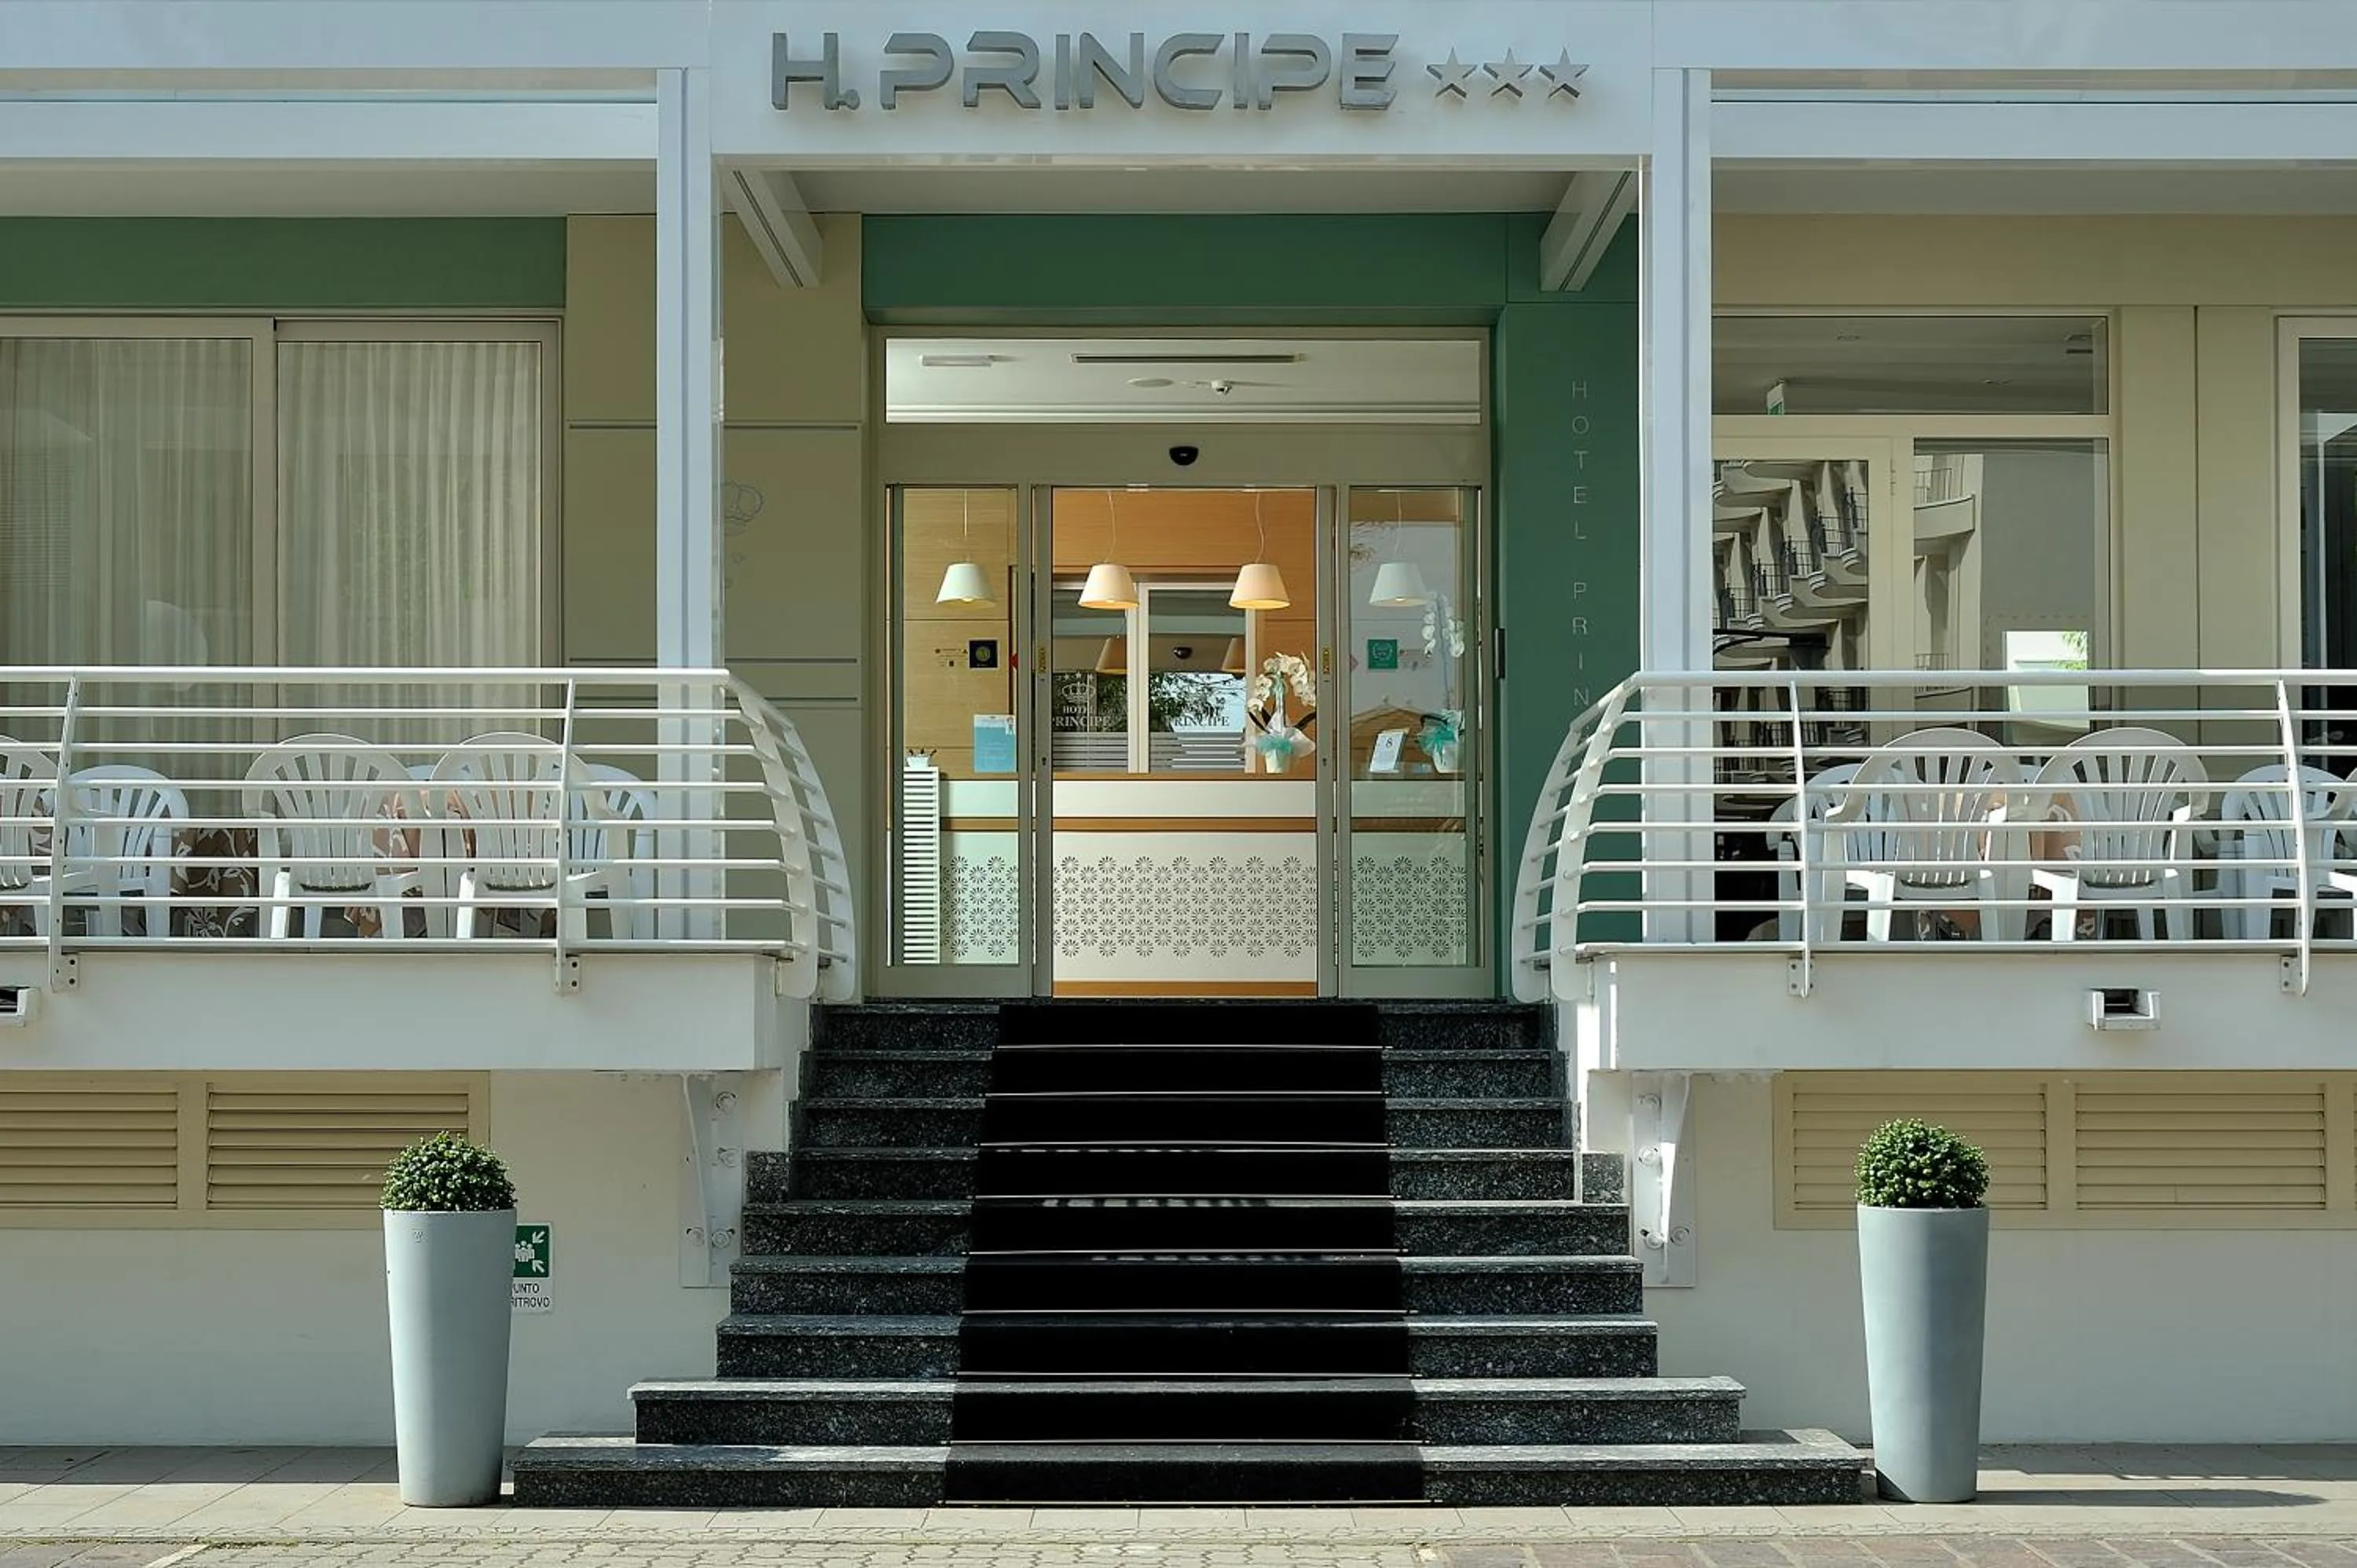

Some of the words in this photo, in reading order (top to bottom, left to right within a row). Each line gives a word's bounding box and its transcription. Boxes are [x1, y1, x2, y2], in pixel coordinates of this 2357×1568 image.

[1572, 381, 1590, 540] HOTEL
[1572, 582, 1590, 707] PRIN
[1052, 715, 1113, 727] RINCIPE
[512, 1283, 541, 1294] UNTO
